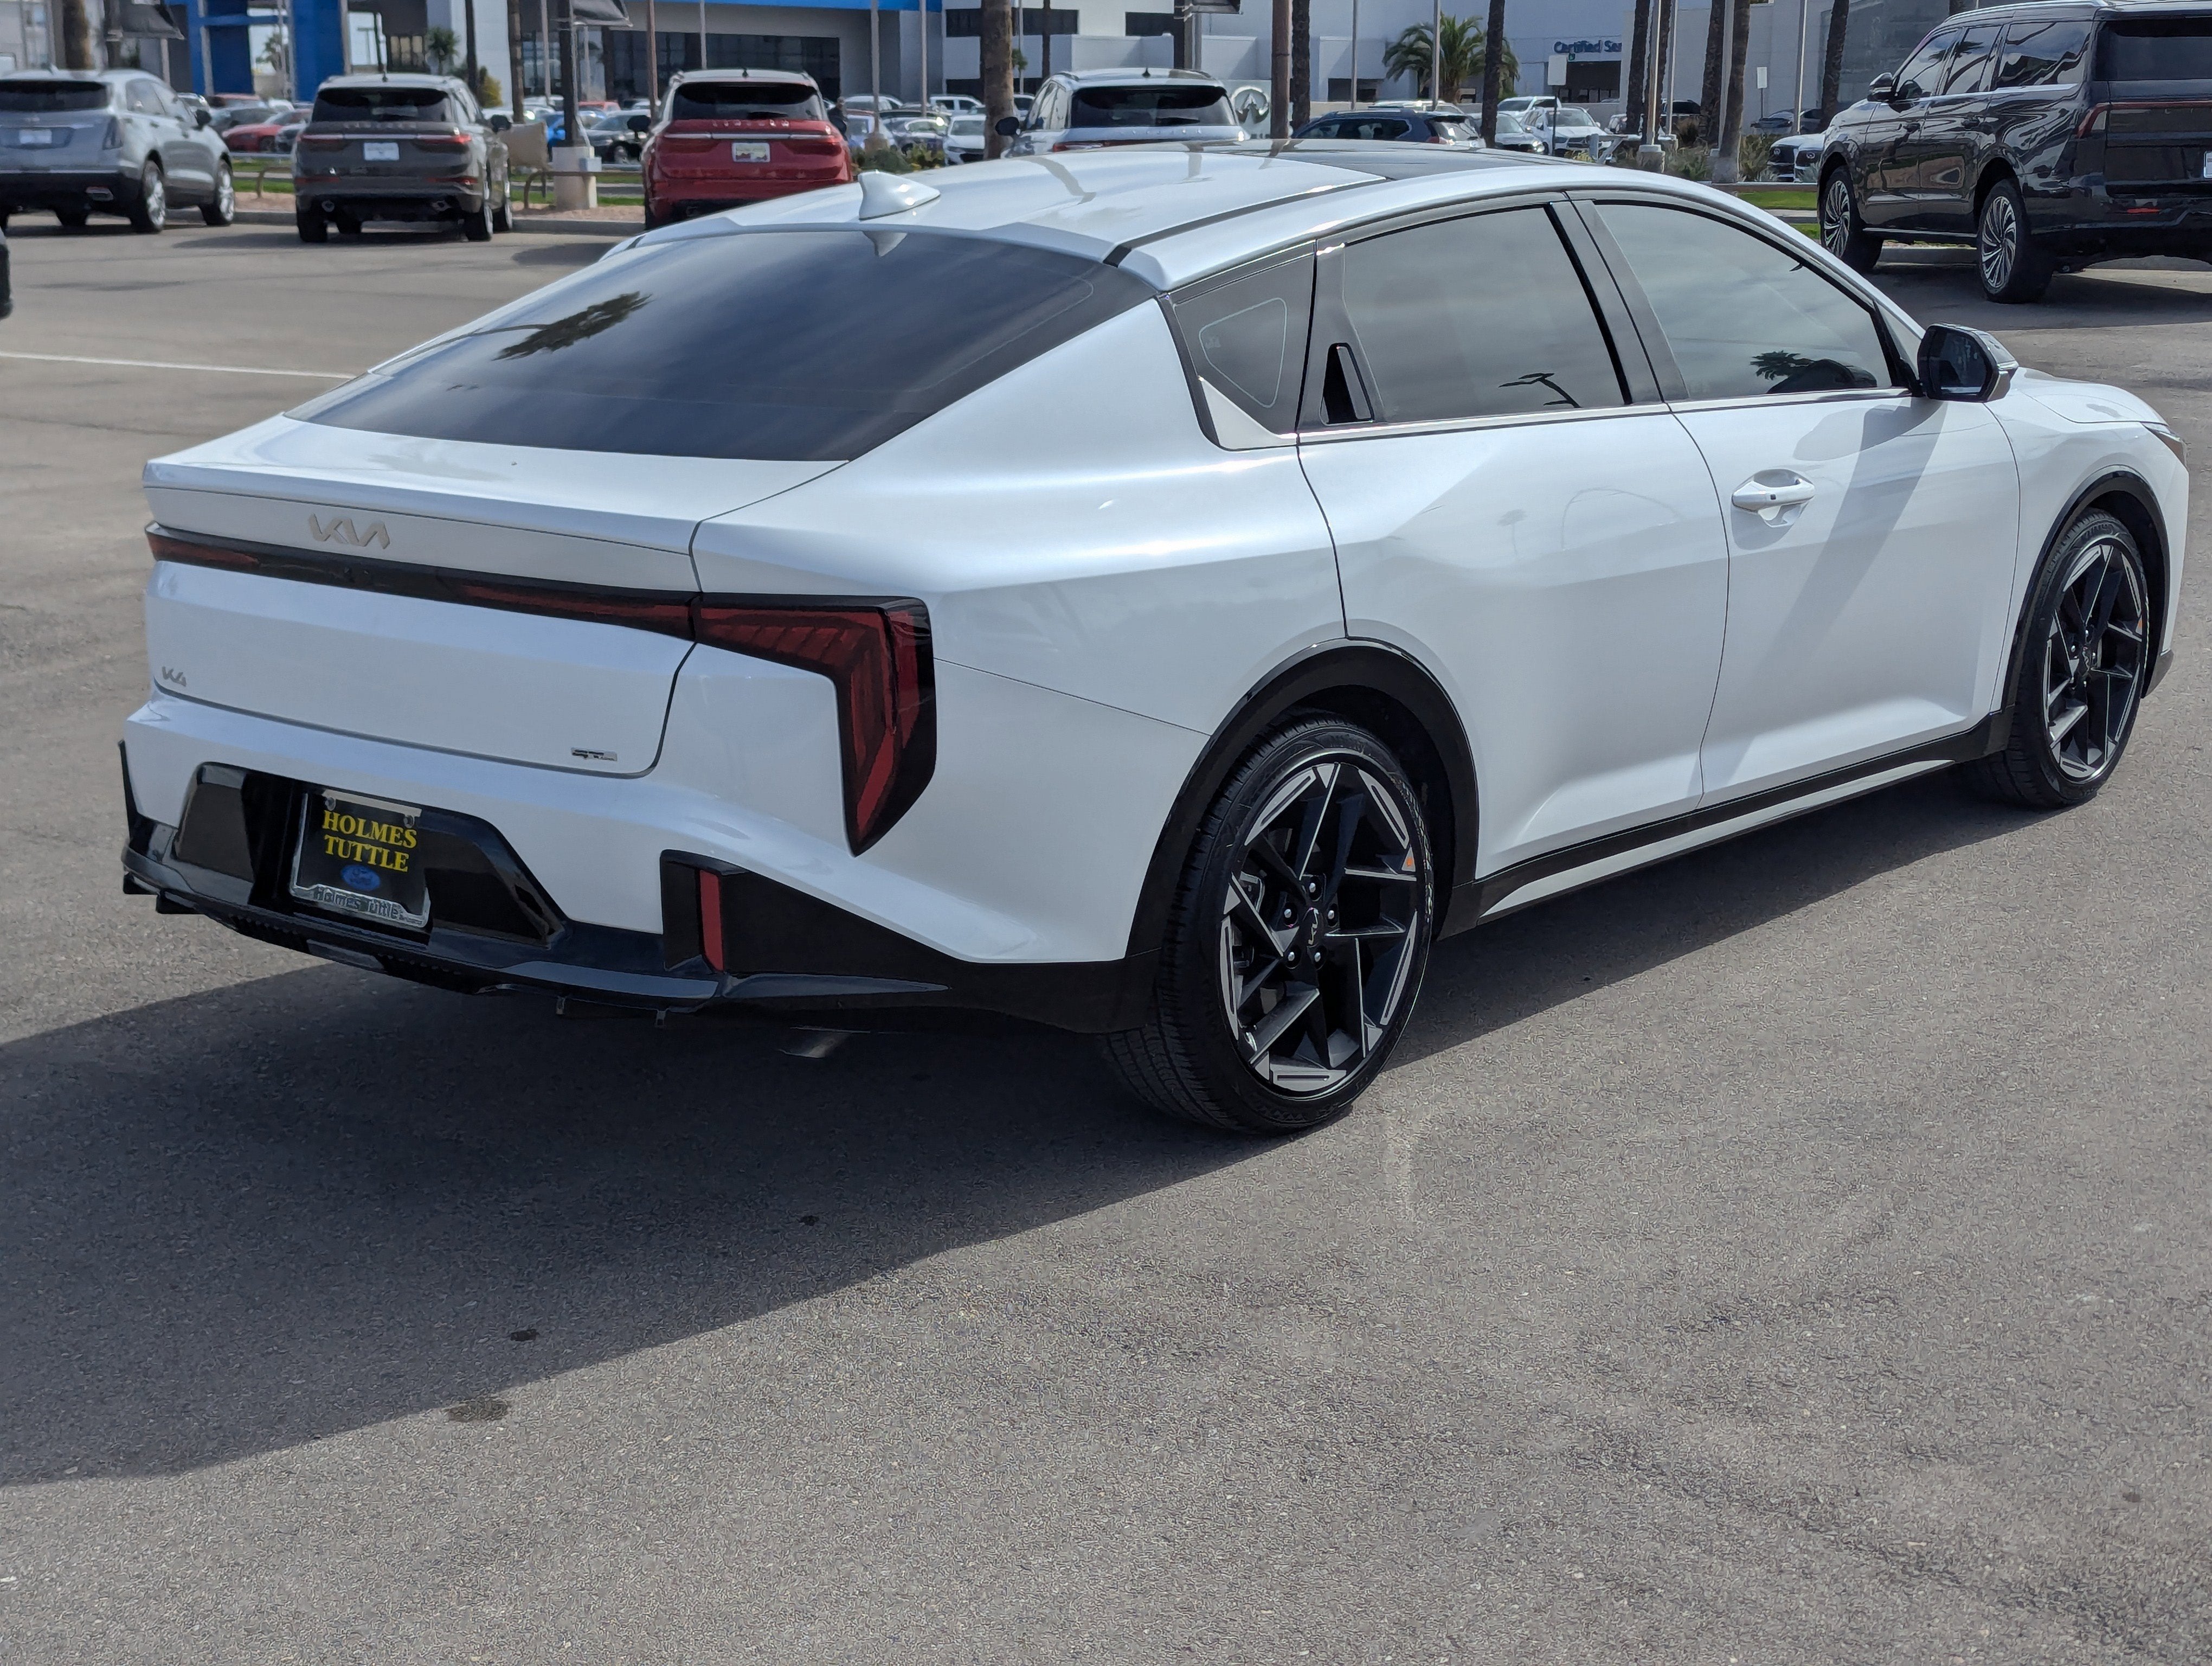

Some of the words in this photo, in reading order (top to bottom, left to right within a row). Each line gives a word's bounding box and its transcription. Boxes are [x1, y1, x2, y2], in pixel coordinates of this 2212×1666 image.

[308, 513, 390, 549] KIA
[322, 810, 417, 849] HOLMES
[324, 834, 409, 872] TUTTLE
